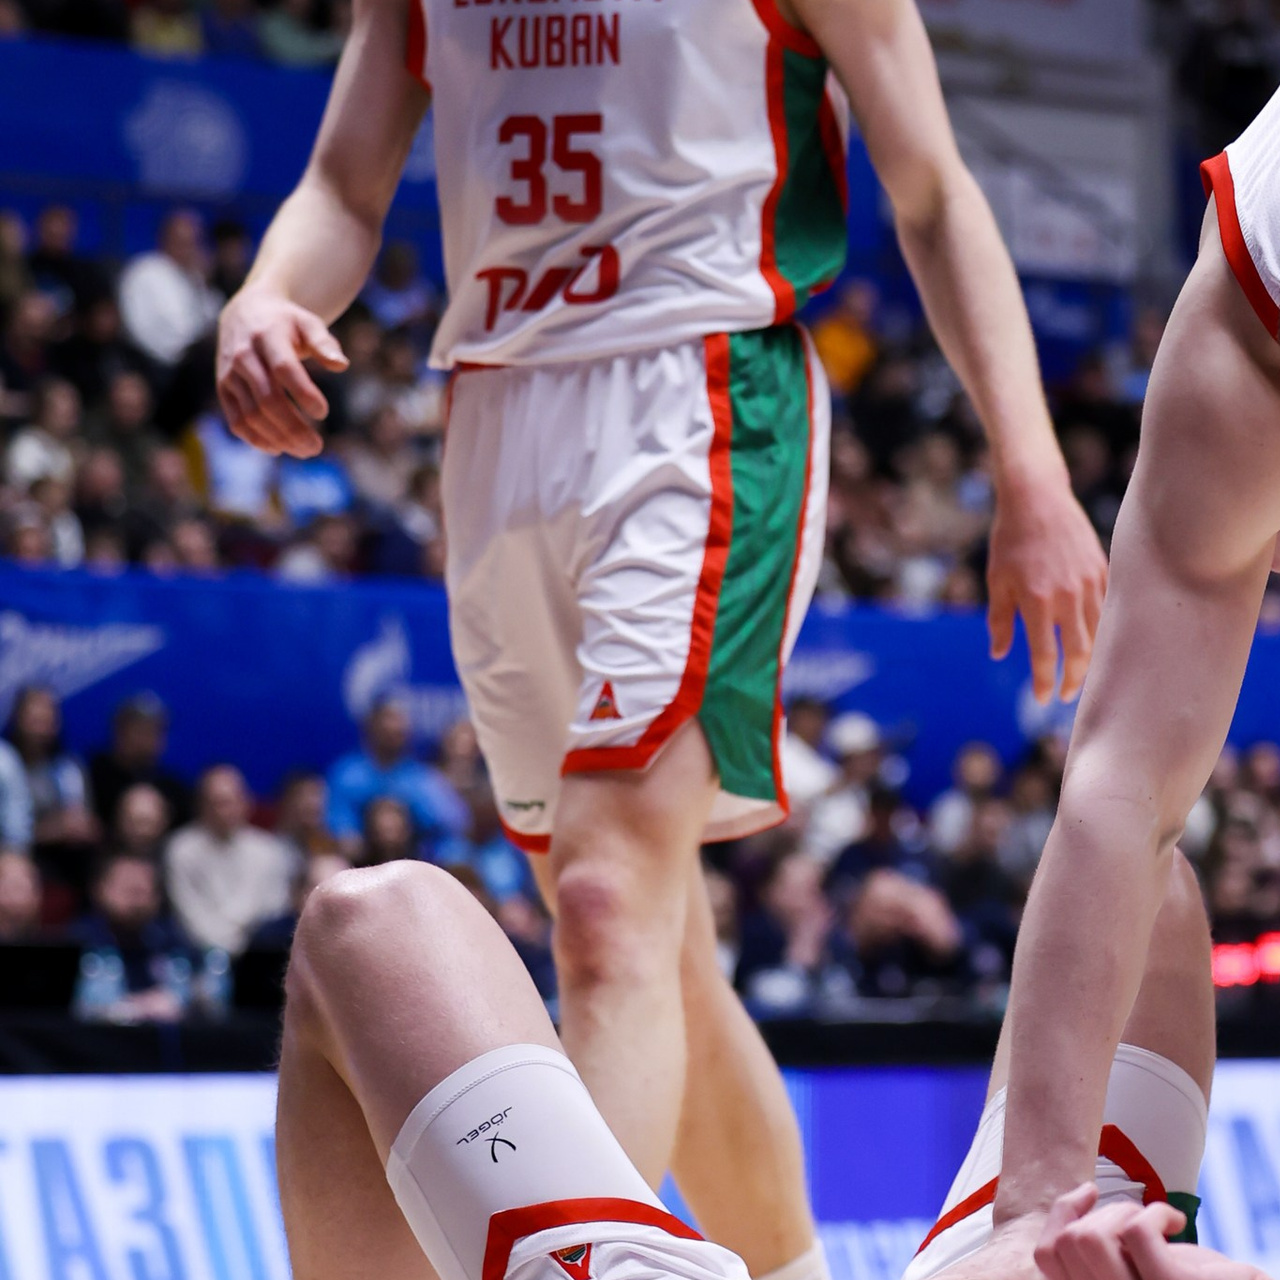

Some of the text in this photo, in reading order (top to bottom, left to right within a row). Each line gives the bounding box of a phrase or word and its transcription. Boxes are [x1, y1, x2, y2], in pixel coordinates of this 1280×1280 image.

[489, 13, 621, 71] KUBAN
[494, 114, 604, 225] 35
[456, 1106, 512, 1145] JÖGEL
